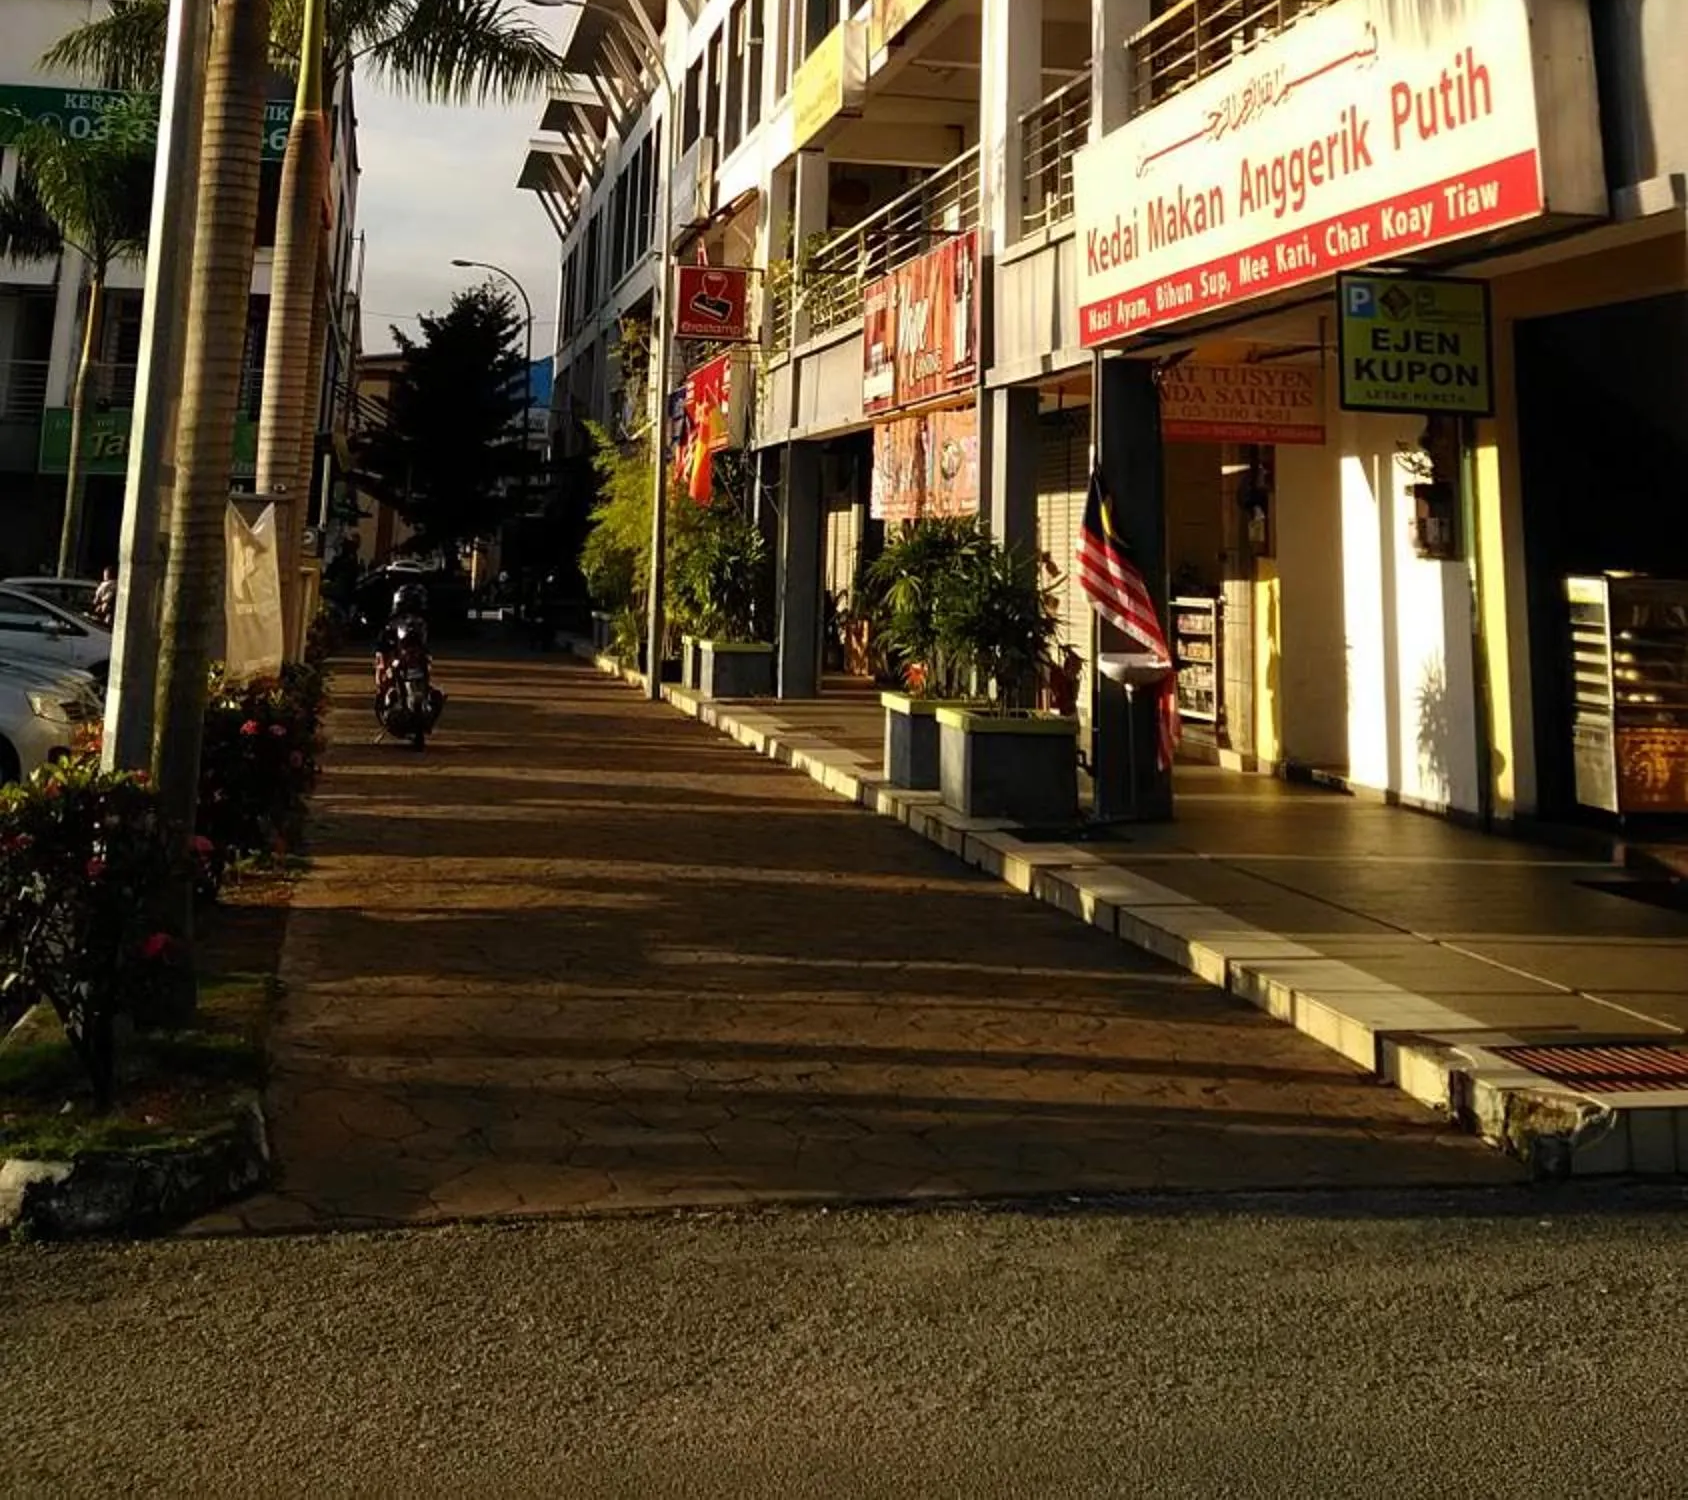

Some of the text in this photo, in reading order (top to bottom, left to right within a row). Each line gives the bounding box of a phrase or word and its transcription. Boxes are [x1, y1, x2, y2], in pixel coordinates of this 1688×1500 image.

[1087, 46, 1493, 277] Kedai Makan Anggerik Putih
[1088, 179, 1500, 333] Nasi Ayam, Bihun Sup, Mee Kari, Char Koay Tiaw
[1351, 286, 1371, 313] P
[1371, 327, 1461, 357] EJEN
[1211, 368, 1314, 389] TUISYEN
[1354, 357, 1480, 387] KUPON
[1215, 386, 1314, 408] SAINTIS
